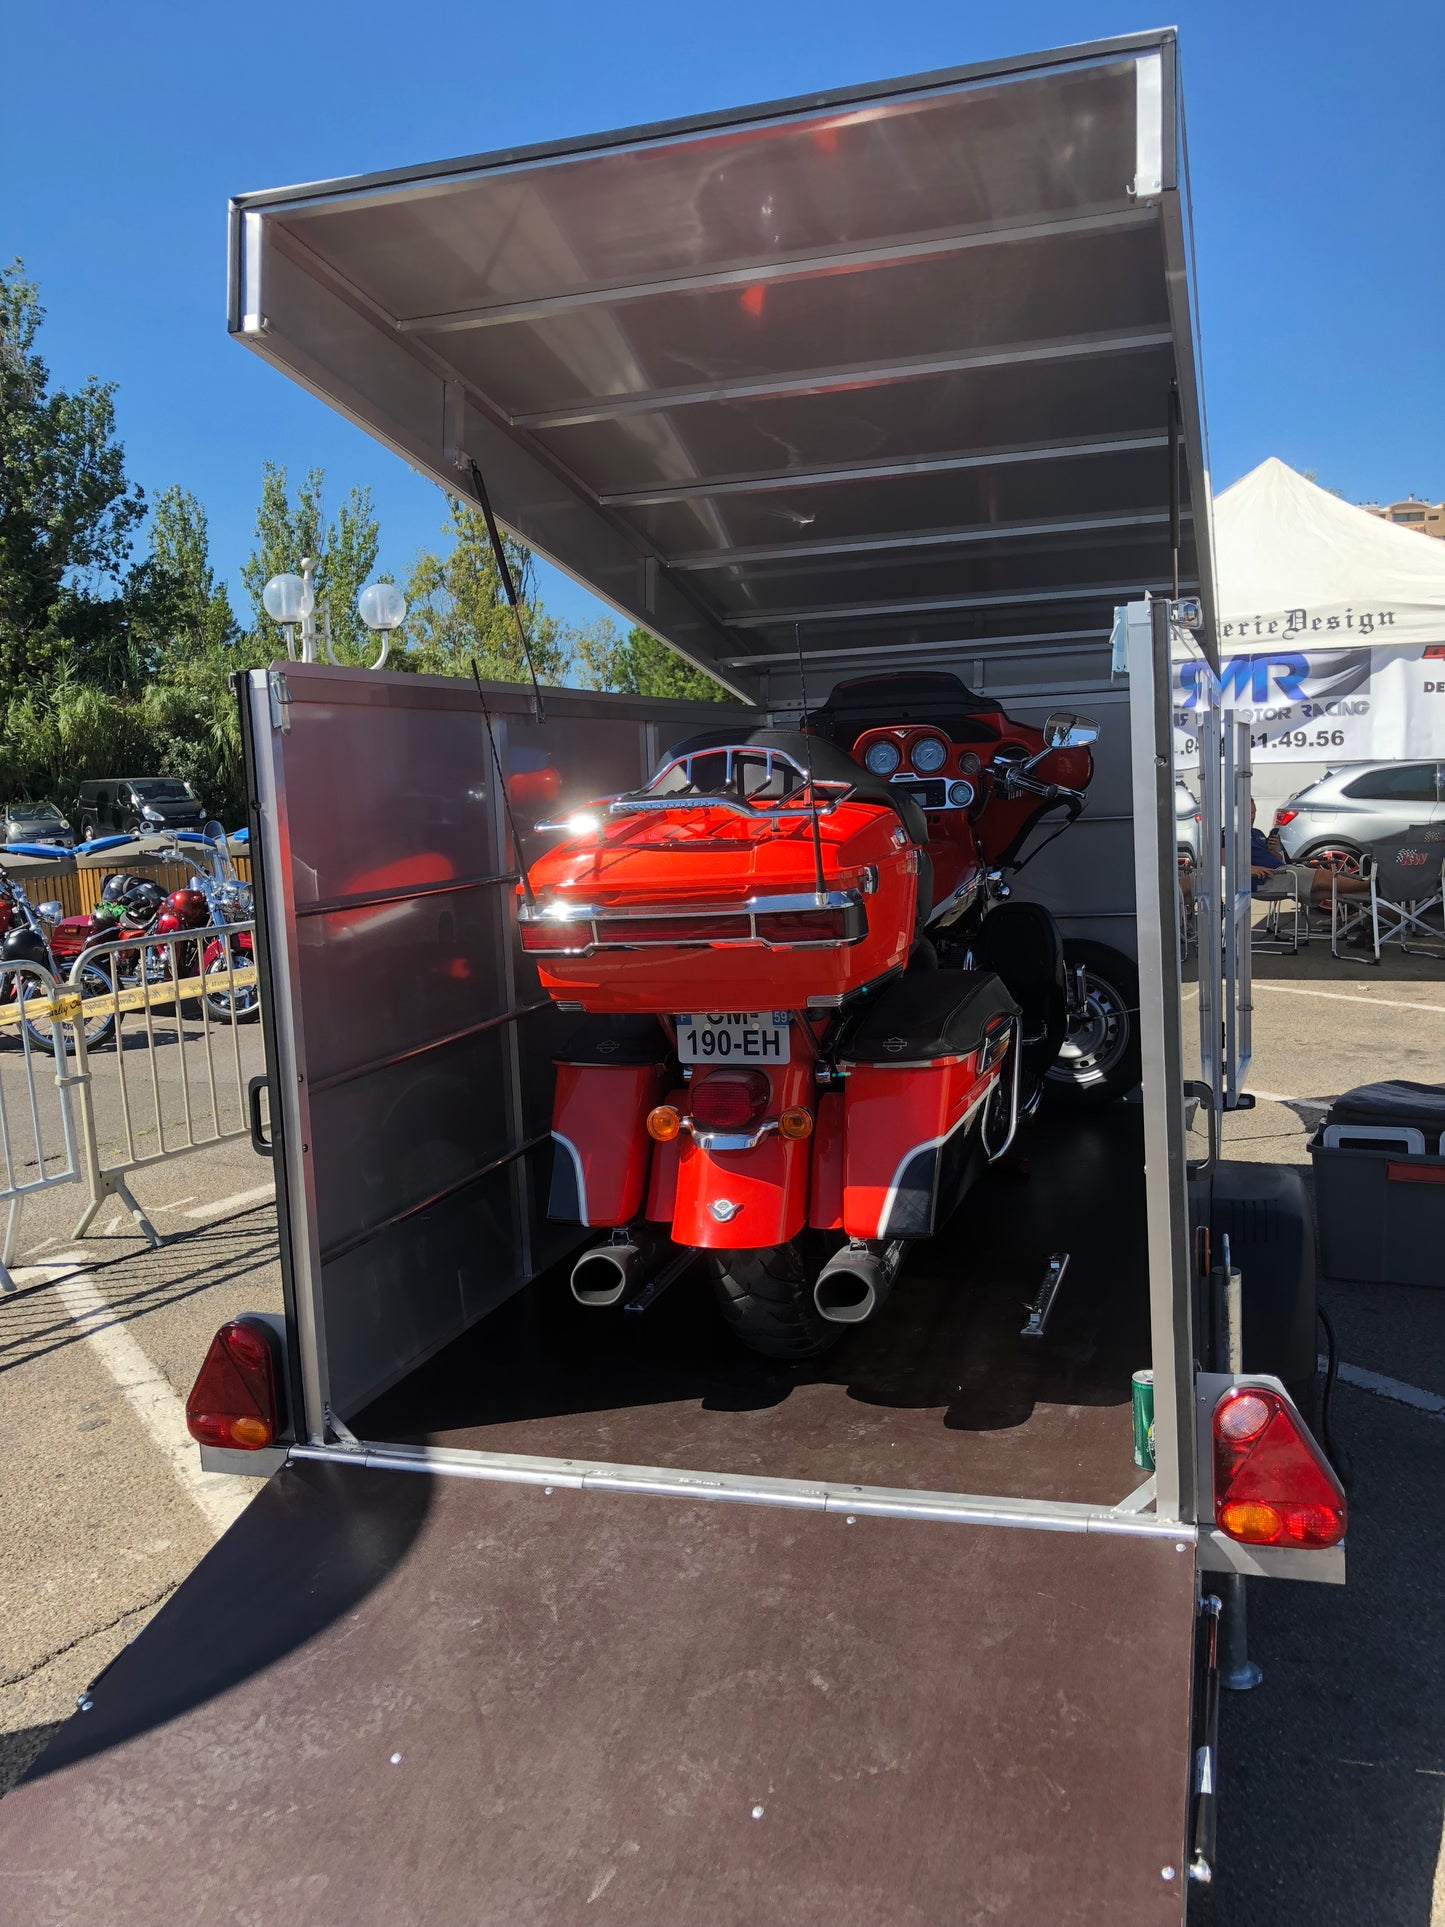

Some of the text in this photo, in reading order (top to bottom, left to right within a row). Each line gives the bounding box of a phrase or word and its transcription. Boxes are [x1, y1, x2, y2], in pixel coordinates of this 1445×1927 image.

[1218, 608, 1395, 640] erie Design
[1301, 700, 1371, 719] RACING
[774, 1011, 787, 1023] 59
[687, 1030, 780, 1056] 190-EH
